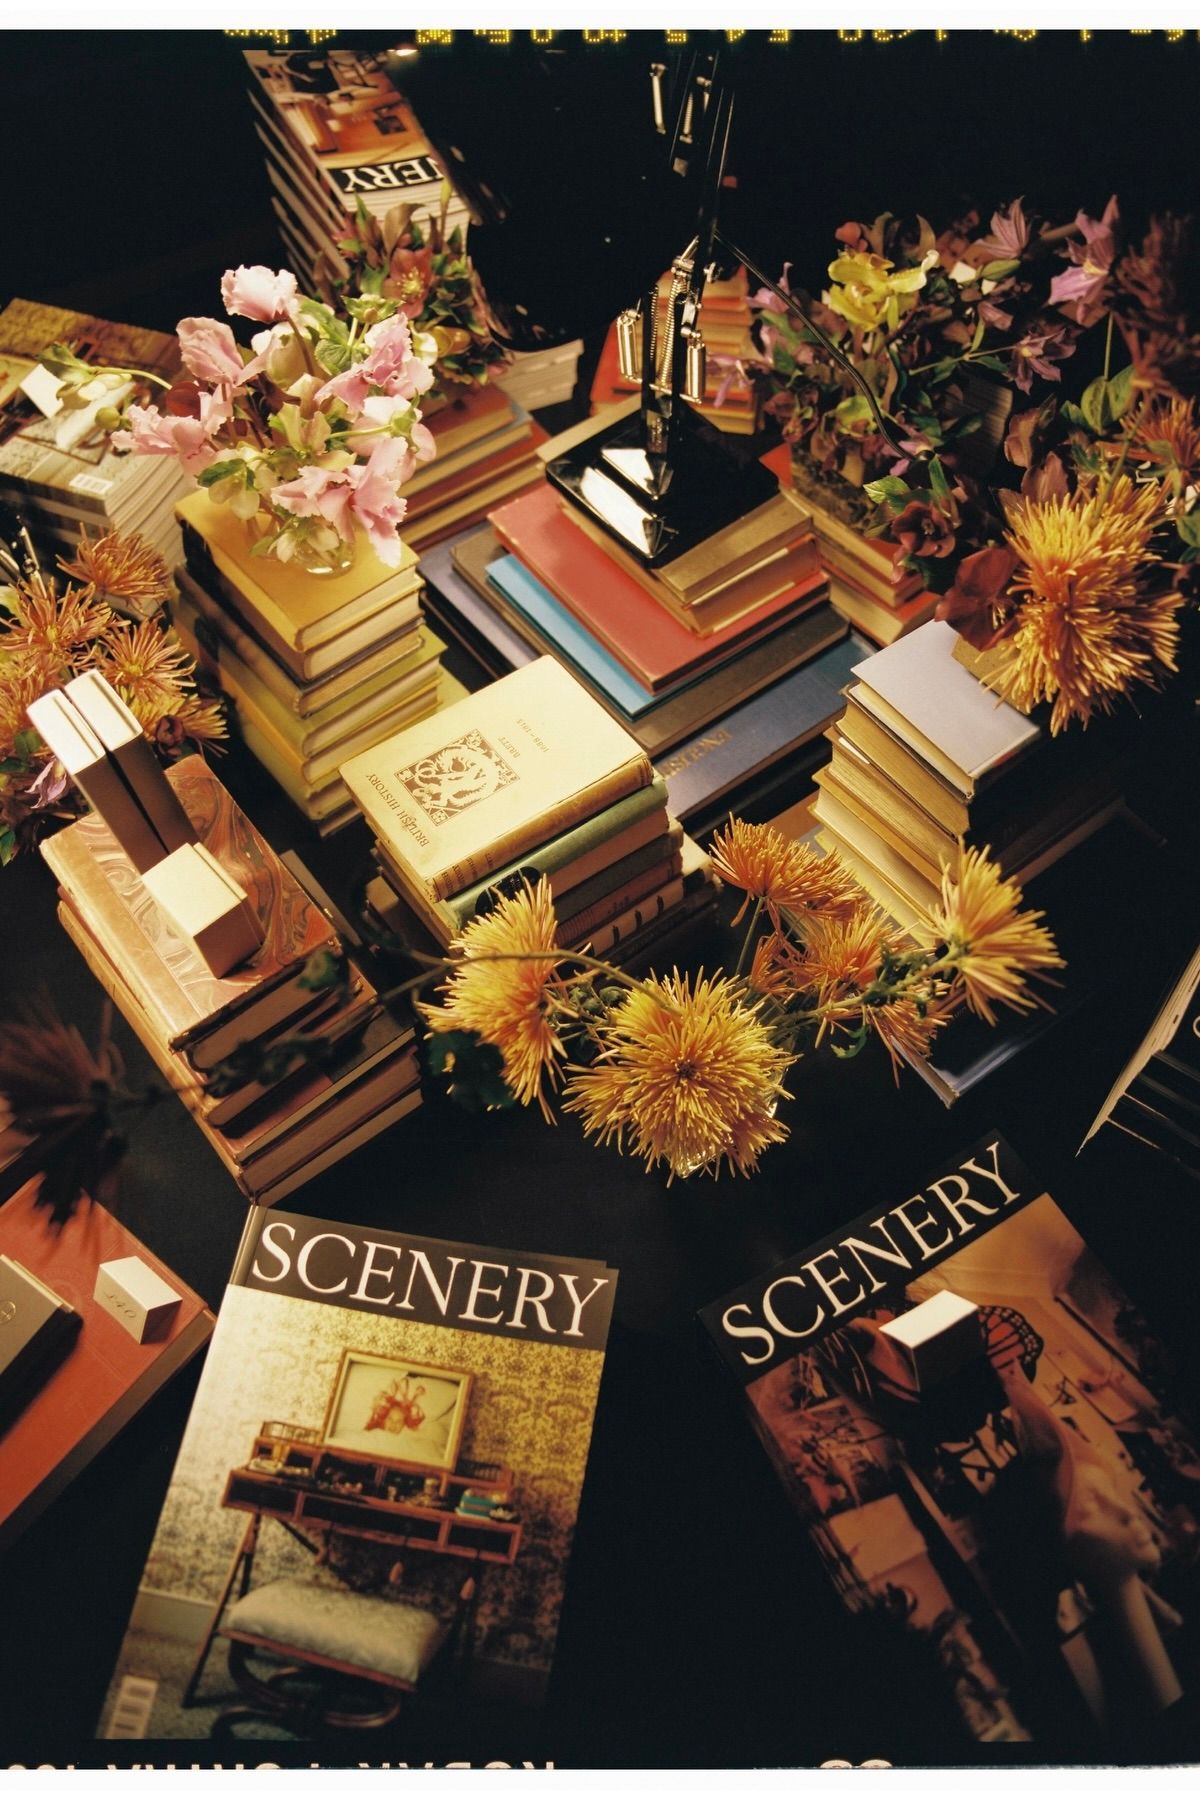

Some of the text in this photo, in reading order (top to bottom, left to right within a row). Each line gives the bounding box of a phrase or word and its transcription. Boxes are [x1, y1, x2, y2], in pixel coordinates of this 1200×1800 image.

[366, 774, 430, 847] BRITISH HISTORY
[252, 1222, 609, 1337] SCENERY
[721, 1141, 1020, 1365] SCENERY
